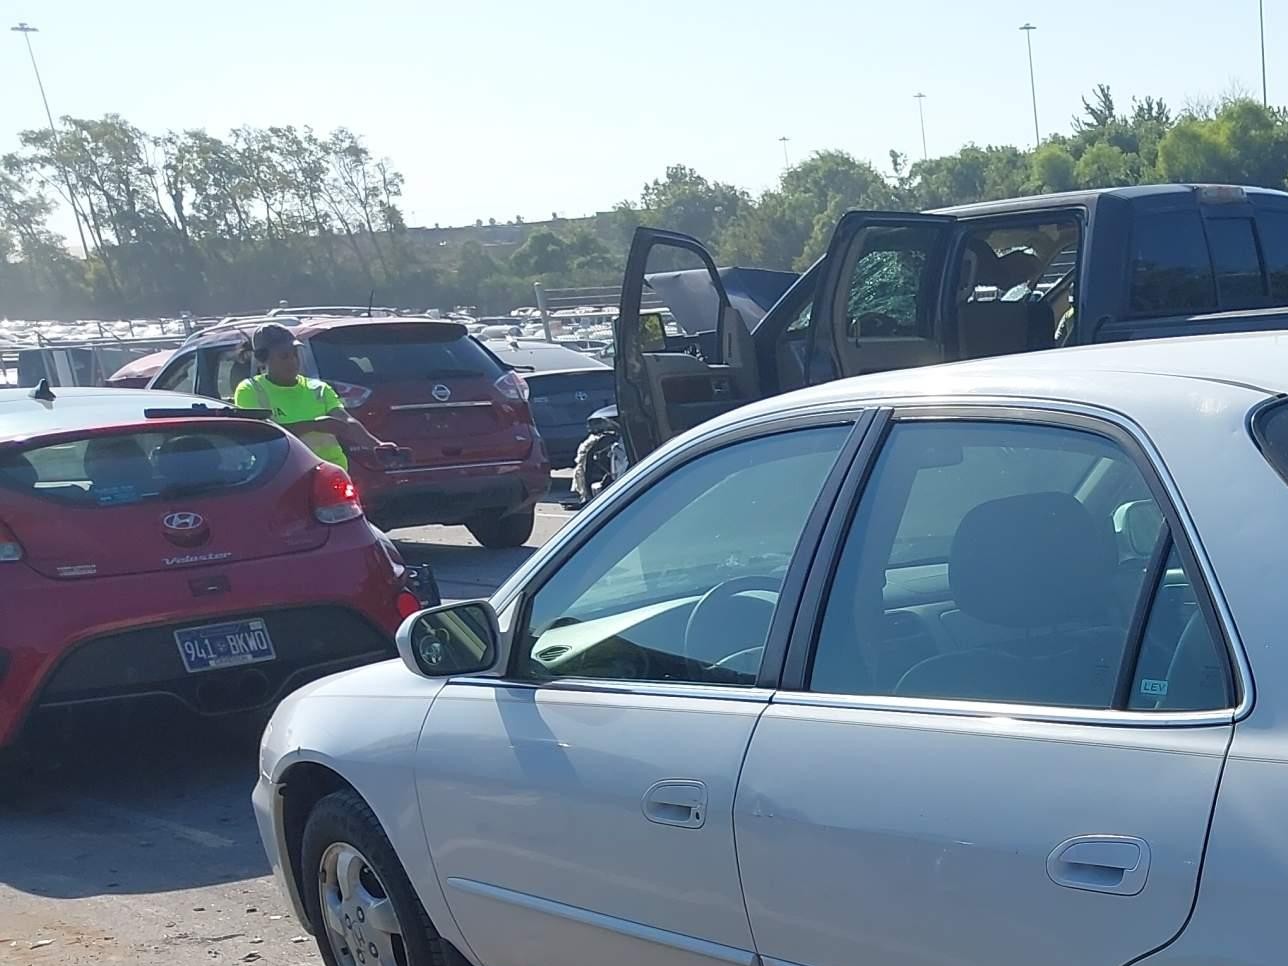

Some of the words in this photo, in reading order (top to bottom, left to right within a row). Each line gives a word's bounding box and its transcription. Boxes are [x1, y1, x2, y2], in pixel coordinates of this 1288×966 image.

[163, 552, 232, 566] Veloster
[184, 638, 217, 661] 941
[1143, 681, 1166, 692] LEV
